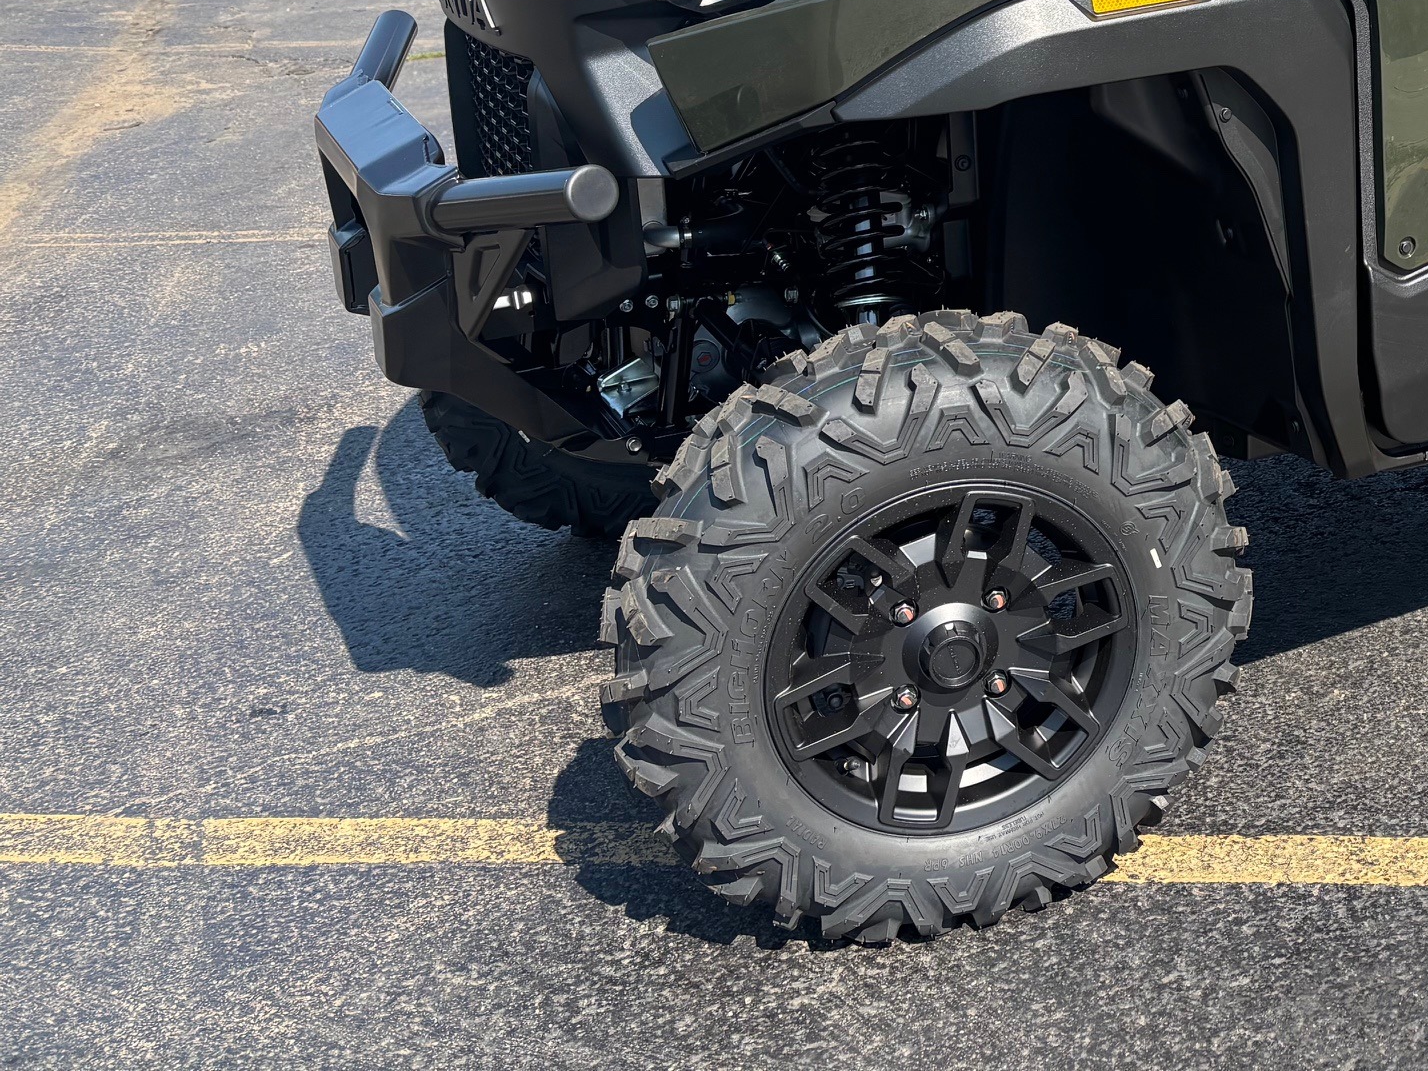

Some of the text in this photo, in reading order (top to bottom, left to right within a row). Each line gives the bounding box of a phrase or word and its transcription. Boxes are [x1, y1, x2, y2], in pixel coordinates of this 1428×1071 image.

[1107, 594, 1171, 769] MAXXIS
[784, 815, 829, 851] RADIAL
[922, 858, 950, 872] 6PR
[957, 850, 984, 868] NHS
